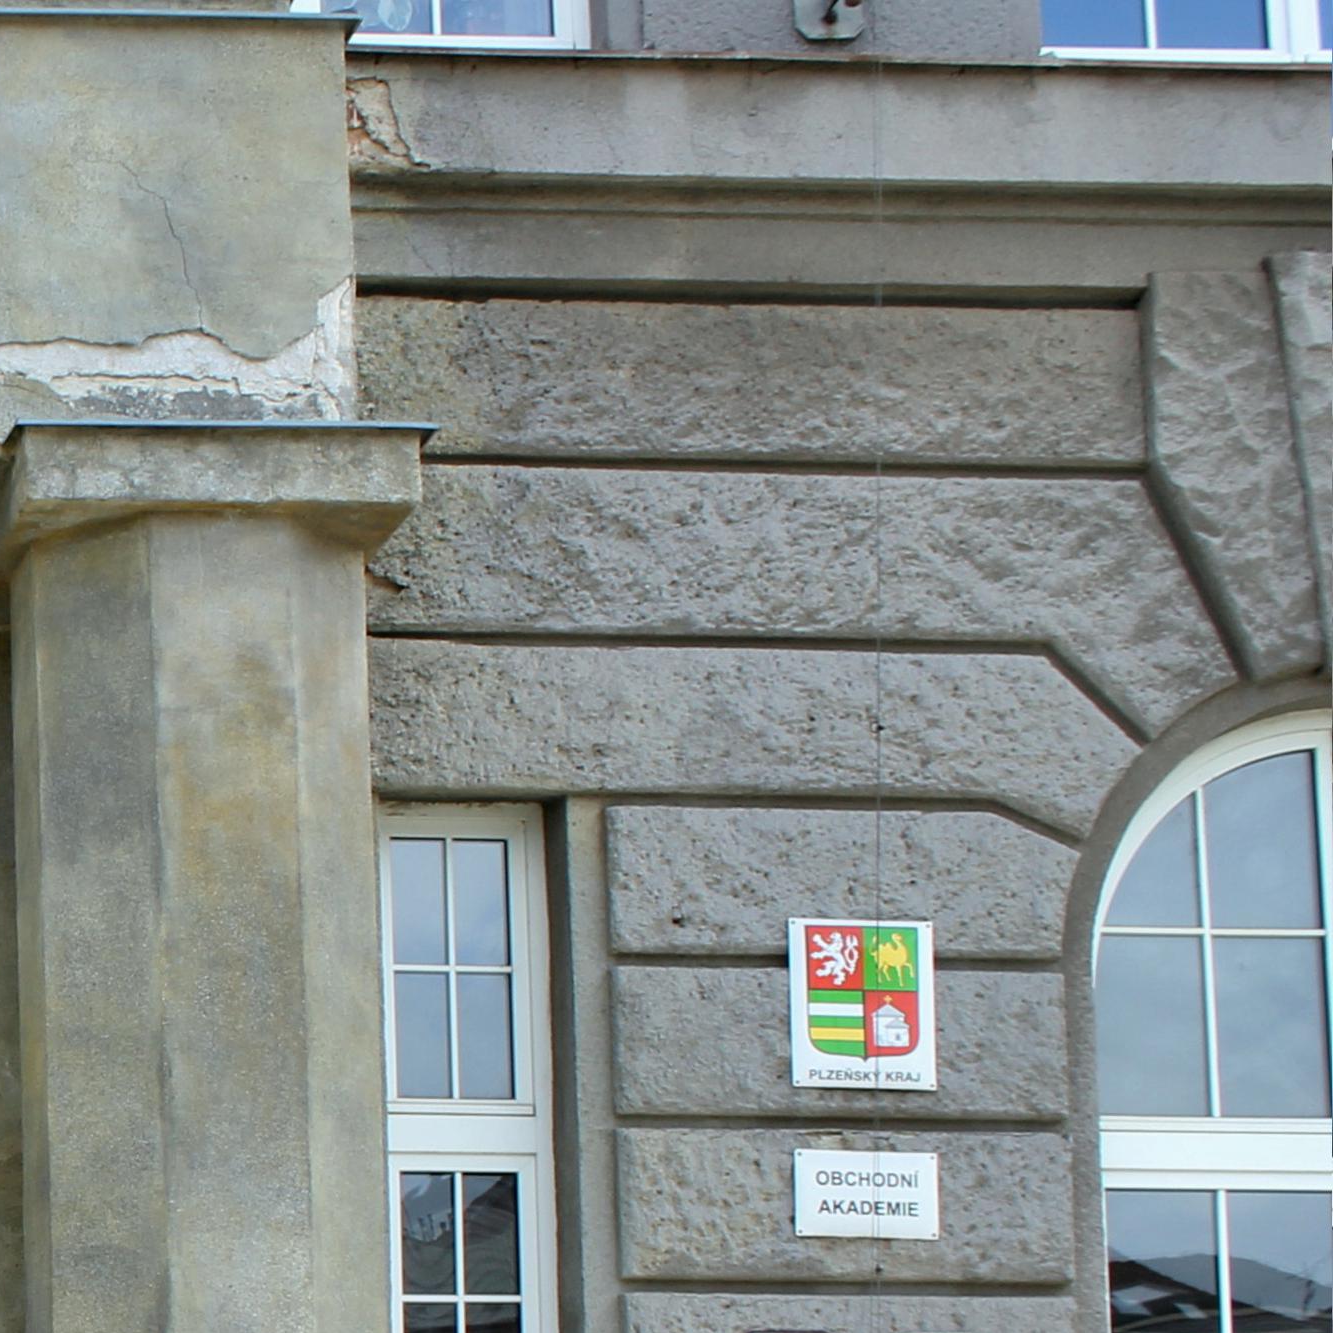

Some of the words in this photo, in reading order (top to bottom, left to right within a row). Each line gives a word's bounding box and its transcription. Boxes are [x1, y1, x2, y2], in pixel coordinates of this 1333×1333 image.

[885, 1072, 921, 1083] KRAJ
[815, 1170, 919, 1189] OBCHODNÍ
[818, 1200, 919, 1217] AKADEMIE
